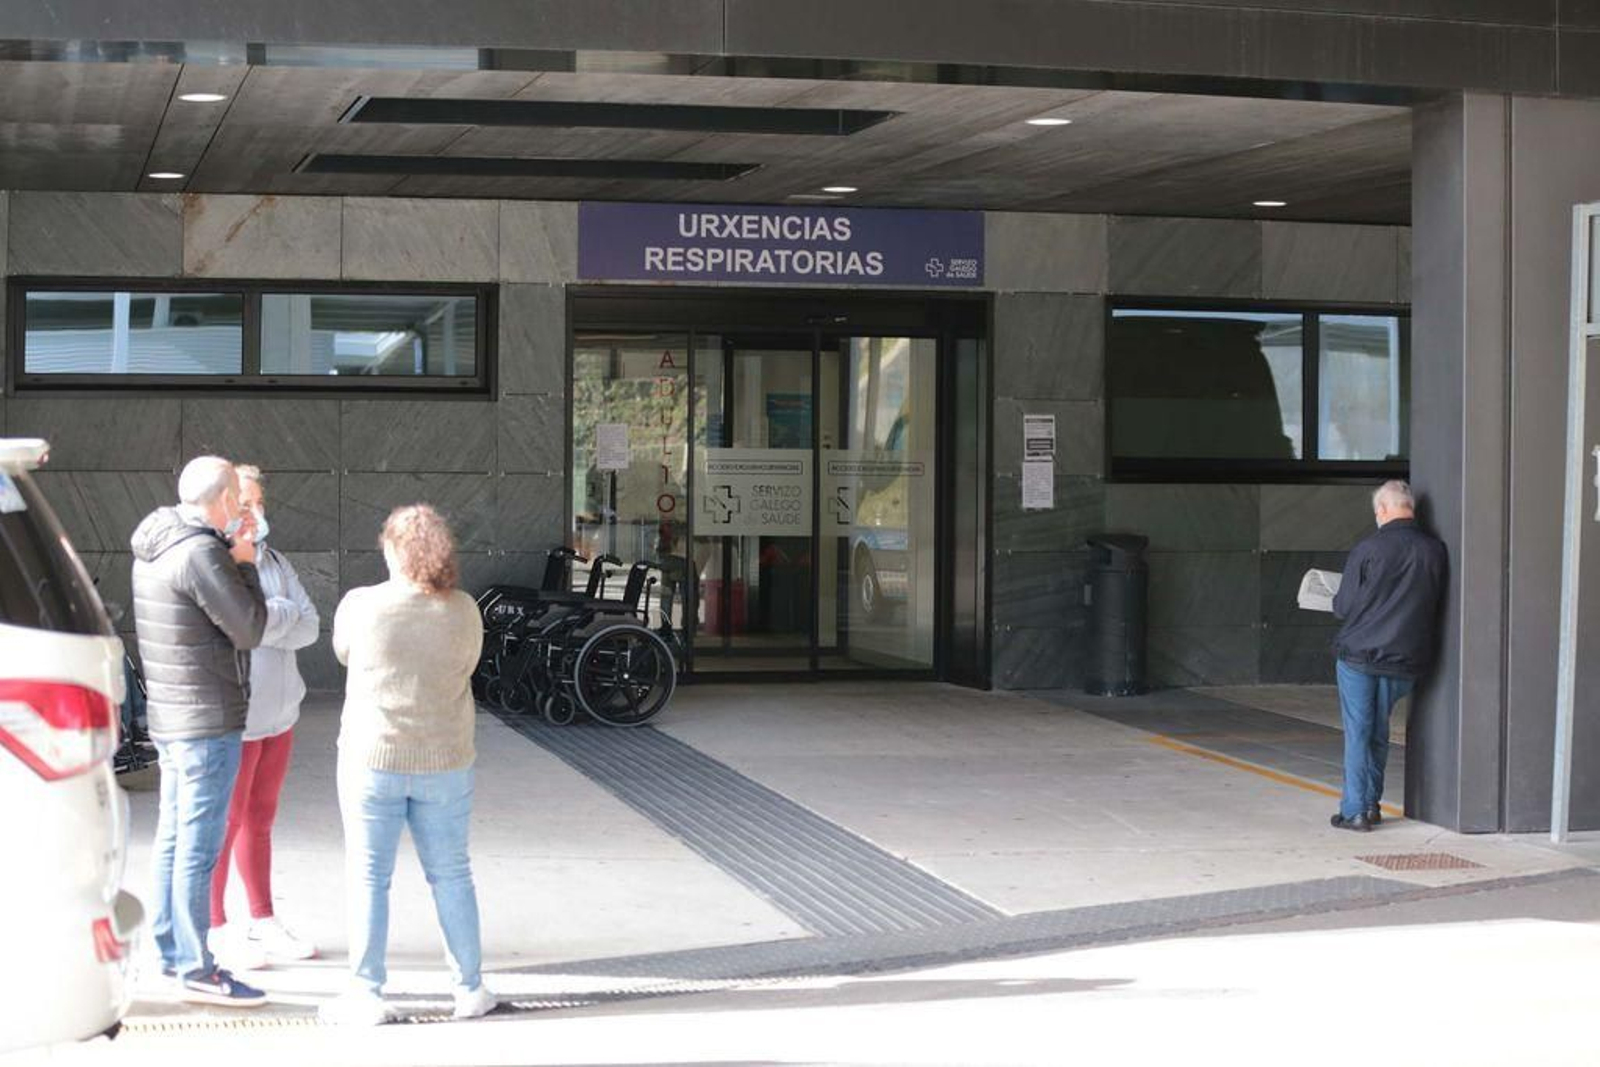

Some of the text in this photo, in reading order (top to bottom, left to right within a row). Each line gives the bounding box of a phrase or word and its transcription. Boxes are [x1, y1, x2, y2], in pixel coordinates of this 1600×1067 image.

[679, 213, 852, 241] URXENCIAS
[644, 246, 884, 276] RESPIRATORIAS
[751, 485, 802, 498] SERVIZO
[749, 499, 802, 511] GALEGO
